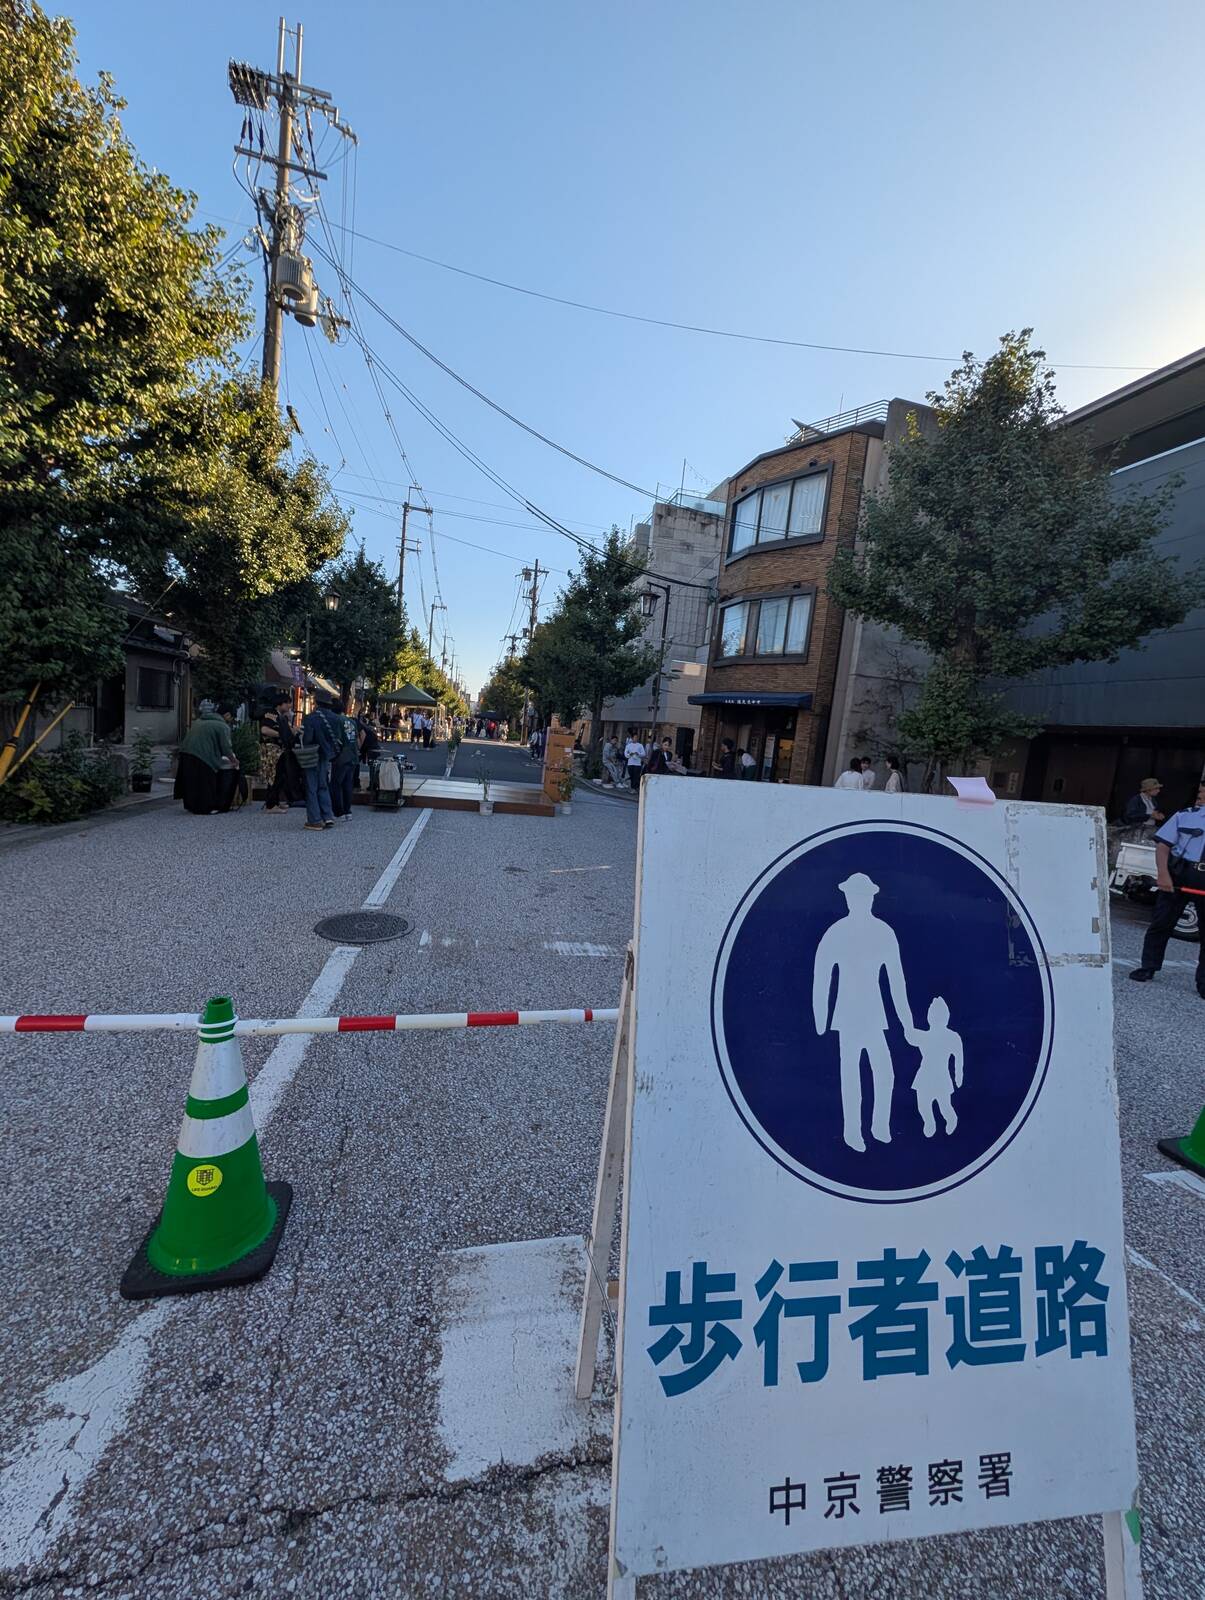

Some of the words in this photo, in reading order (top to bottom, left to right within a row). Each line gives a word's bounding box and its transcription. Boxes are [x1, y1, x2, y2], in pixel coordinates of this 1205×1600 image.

[647, 1240, 1110, 1397] 歩行者道路
[769, 1452, 1013, 1526] 中京警察署
